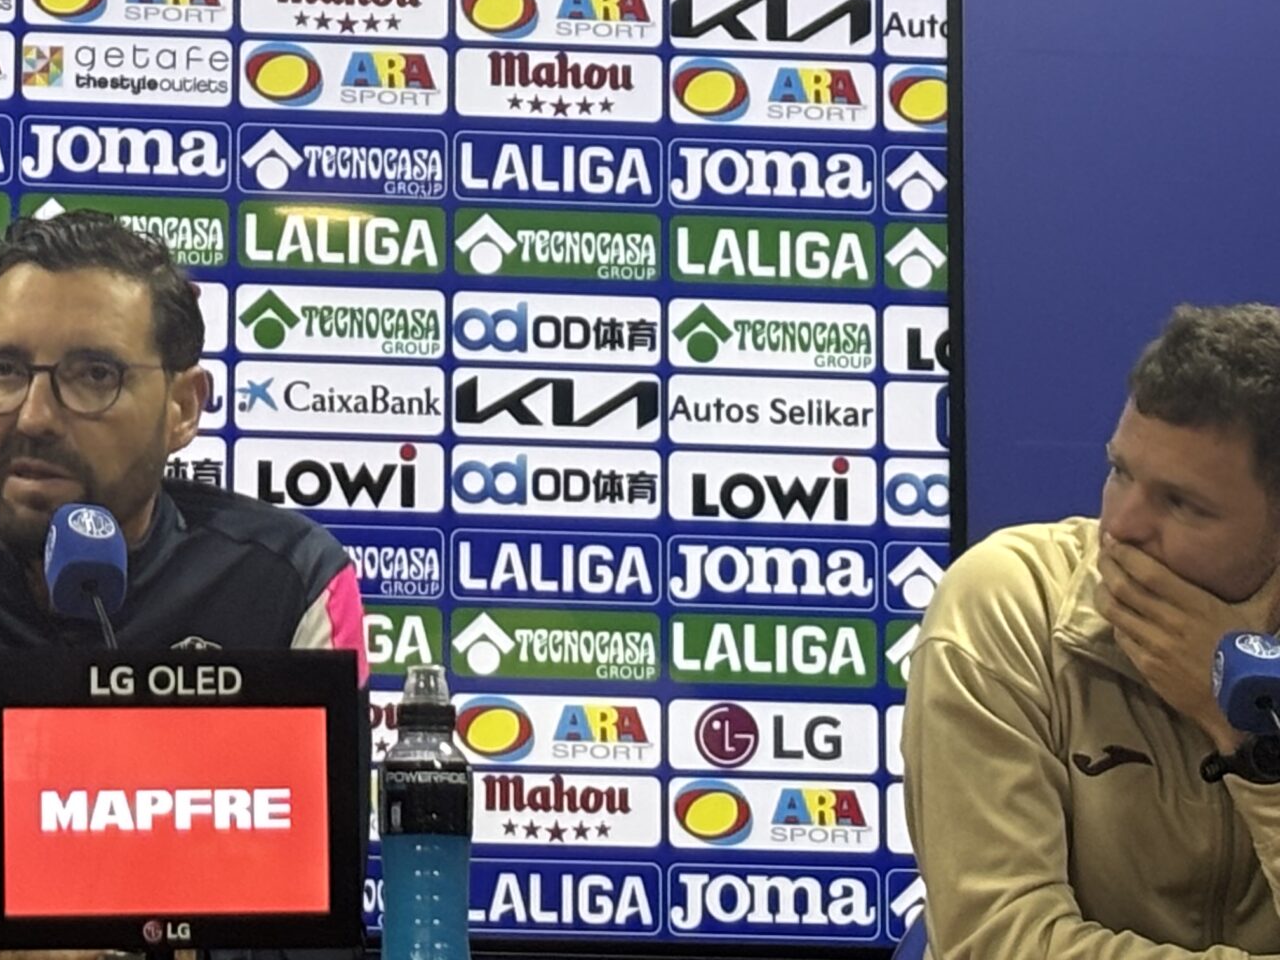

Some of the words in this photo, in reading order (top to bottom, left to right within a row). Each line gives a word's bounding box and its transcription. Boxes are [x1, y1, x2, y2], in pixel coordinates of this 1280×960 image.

[124, 5, 217, 24] SPORT
[555, 20, 650, 39] SPORT
[75, 44, 229, 71] getafe
[340, 51, 436, 89] ARA
[488, 51, 634, 91] Mahou
[340, 88, 435, 106] SPORT
[768, 67, 862, 104] ARA
[766, 104, 862, 122] SPORT
[305, 146, 442, 183] TECNOCASA
[461, 142, 652, 194] LALIGA
[384, 180, 443, 196] GROUP
[246, 213, 438, 266] LALIGA
[517, 230, 656, 266] TECNOCASA
[677, 227, 869, 280] LALIGA
[597, 265, 656, 280] GROUP
[301, 304, 440, 340] TECNOCASA
[532, 315, 657, 352] OD体育
[734, 320, 872, 355] TECNOCASA
[382, 340, 440, 355] GROUP
[814, 354, 872, 369] GROUP
[284, 381, 441, 416] CaixaBank
[455, 376, 659, 429] KIA
[670, 396, 759, 424] Autos
[770, 399, 873, 428] Selikar
[531, 468, 657, 505] OD体育
[459, 542, 652, 593] LALIGA
[514, 629, 656, 666] TECNOCASA
[673, 623, 866, 675] LALIGA
[89, 667, 134, 696] LG
[148, 667, 242, 696] OLED
[596, 664, 655, 680] GROUP
[553, 705, 648, 743] ARA
[772, 715, 843, 761] LG
[552, 742, 647, 760] SPORT
[386, 772, 467, 784] POWERADE
[482, 773, 631, 813] Mahou
[41, 788, 291, 832] MAPFRE
[771, 788, 866, 825] ARA
[770, 825, 866, 844] SPORT
[167, 923, 190, 939] LG
